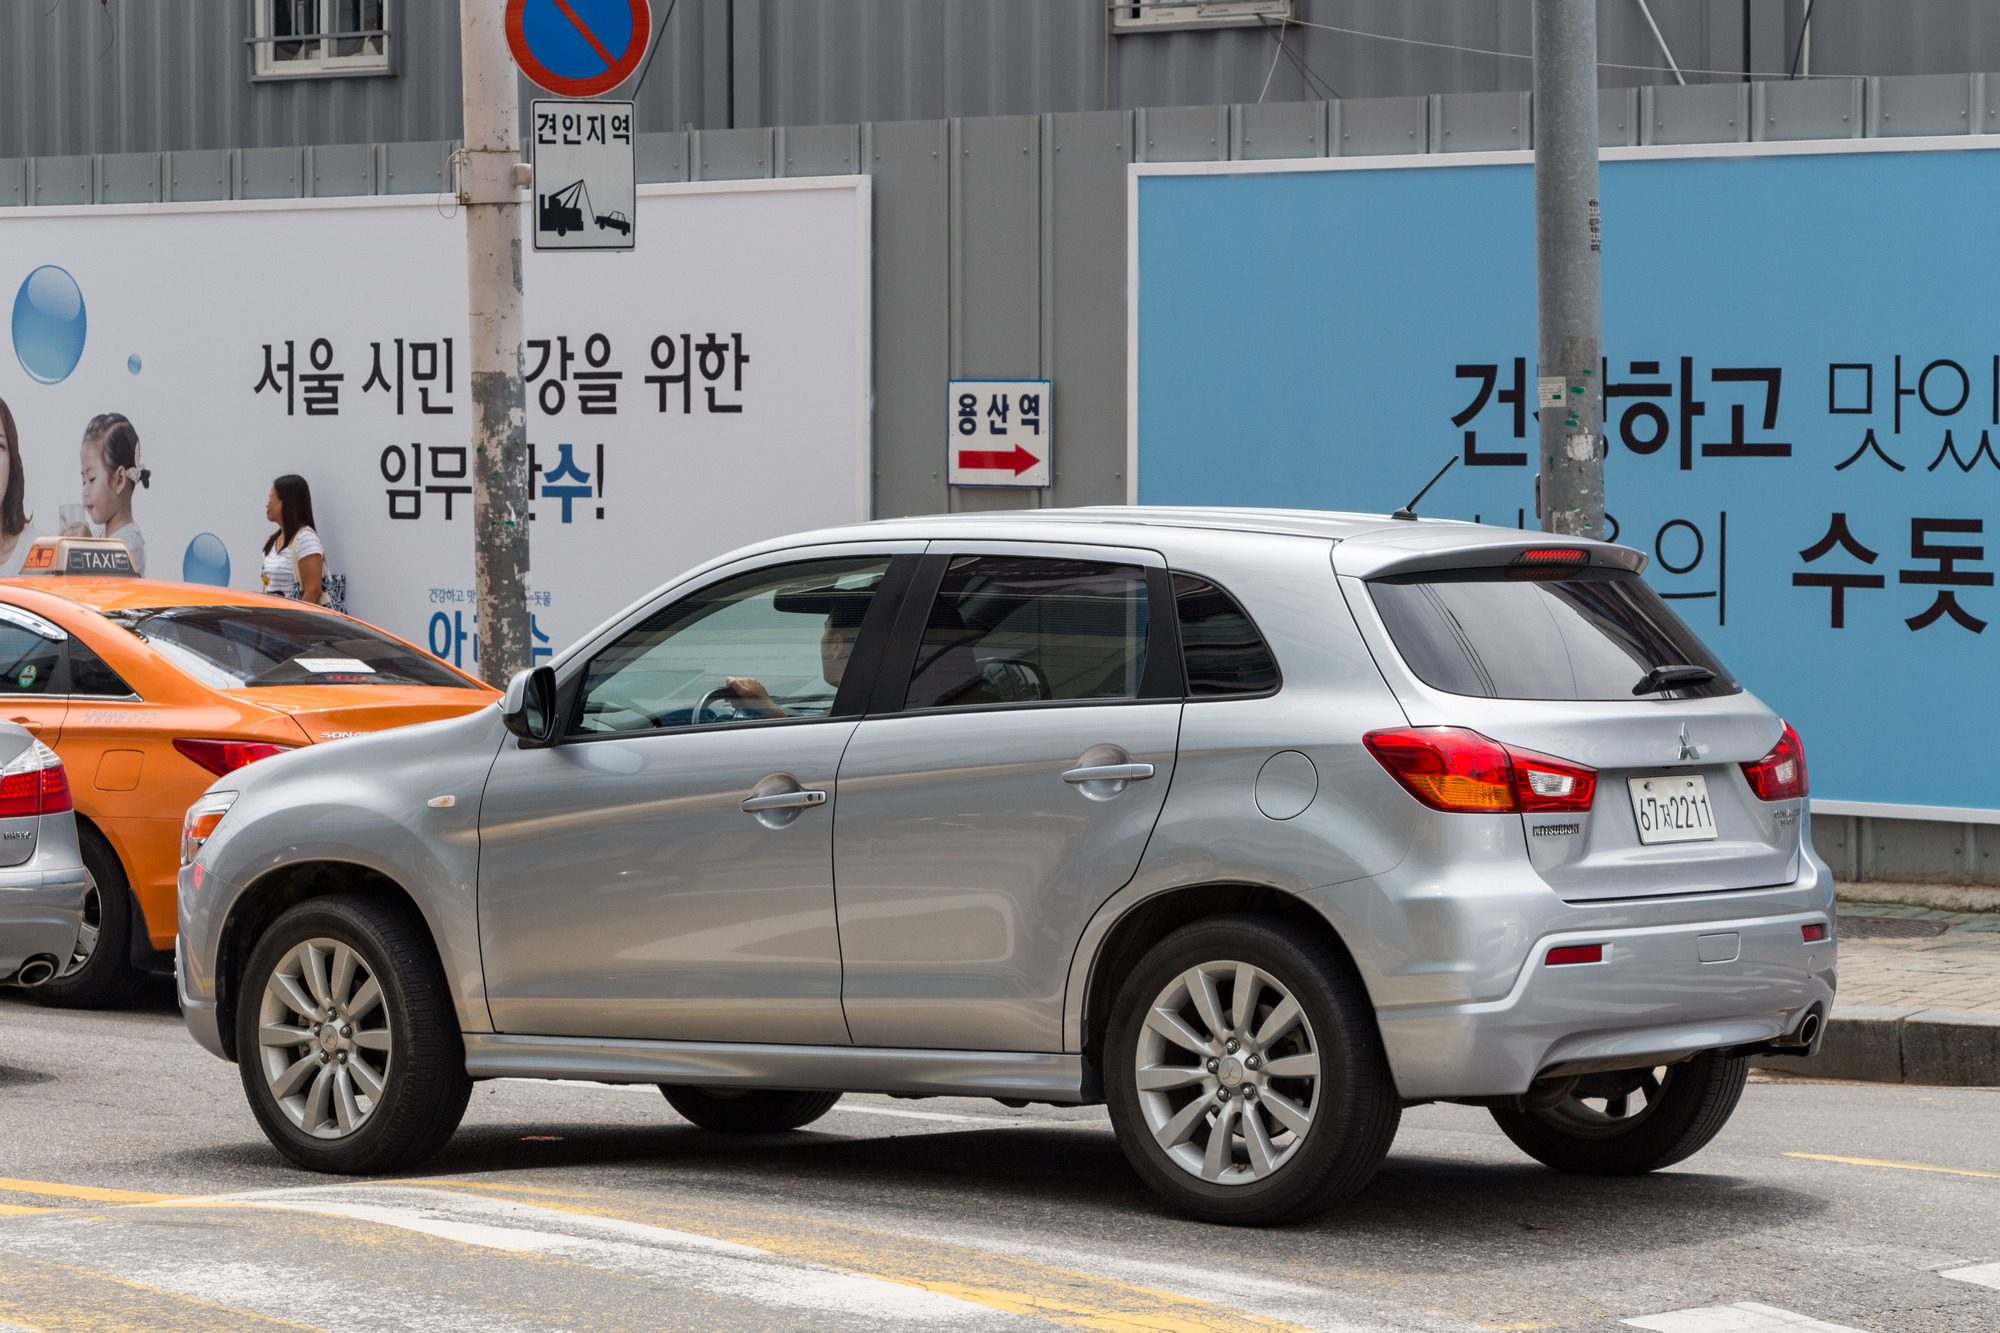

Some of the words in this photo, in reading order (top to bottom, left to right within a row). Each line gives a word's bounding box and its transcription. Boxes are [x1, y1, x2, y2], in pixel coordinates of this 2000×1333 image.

[537, 113, 630, 145] 견인지역
[254, 337, 344, 416] 서울
[362, 337, 453, 416] 시민
[525, 333, 622, 416] 강을
[644, 333, 750, 415] 위한
[958, 393, 1040, 436] 용산역
[1450, 356, 1792, 471] 건하고
[1828, 354, 2000, 473] 맛있
[380, 442, 472, 521] 임무
[83, 552, 116, 568] TAXI
[1792, 512, 1995, 635] 수돗
[428, 588, 464, 603] 건강하고
[530, 591, 552, 607] 돗물
[128, 712, 158, 724] 072
[320, 732, 369, 740] SONA
[1640, 794, 1712, 831] 67저2211
